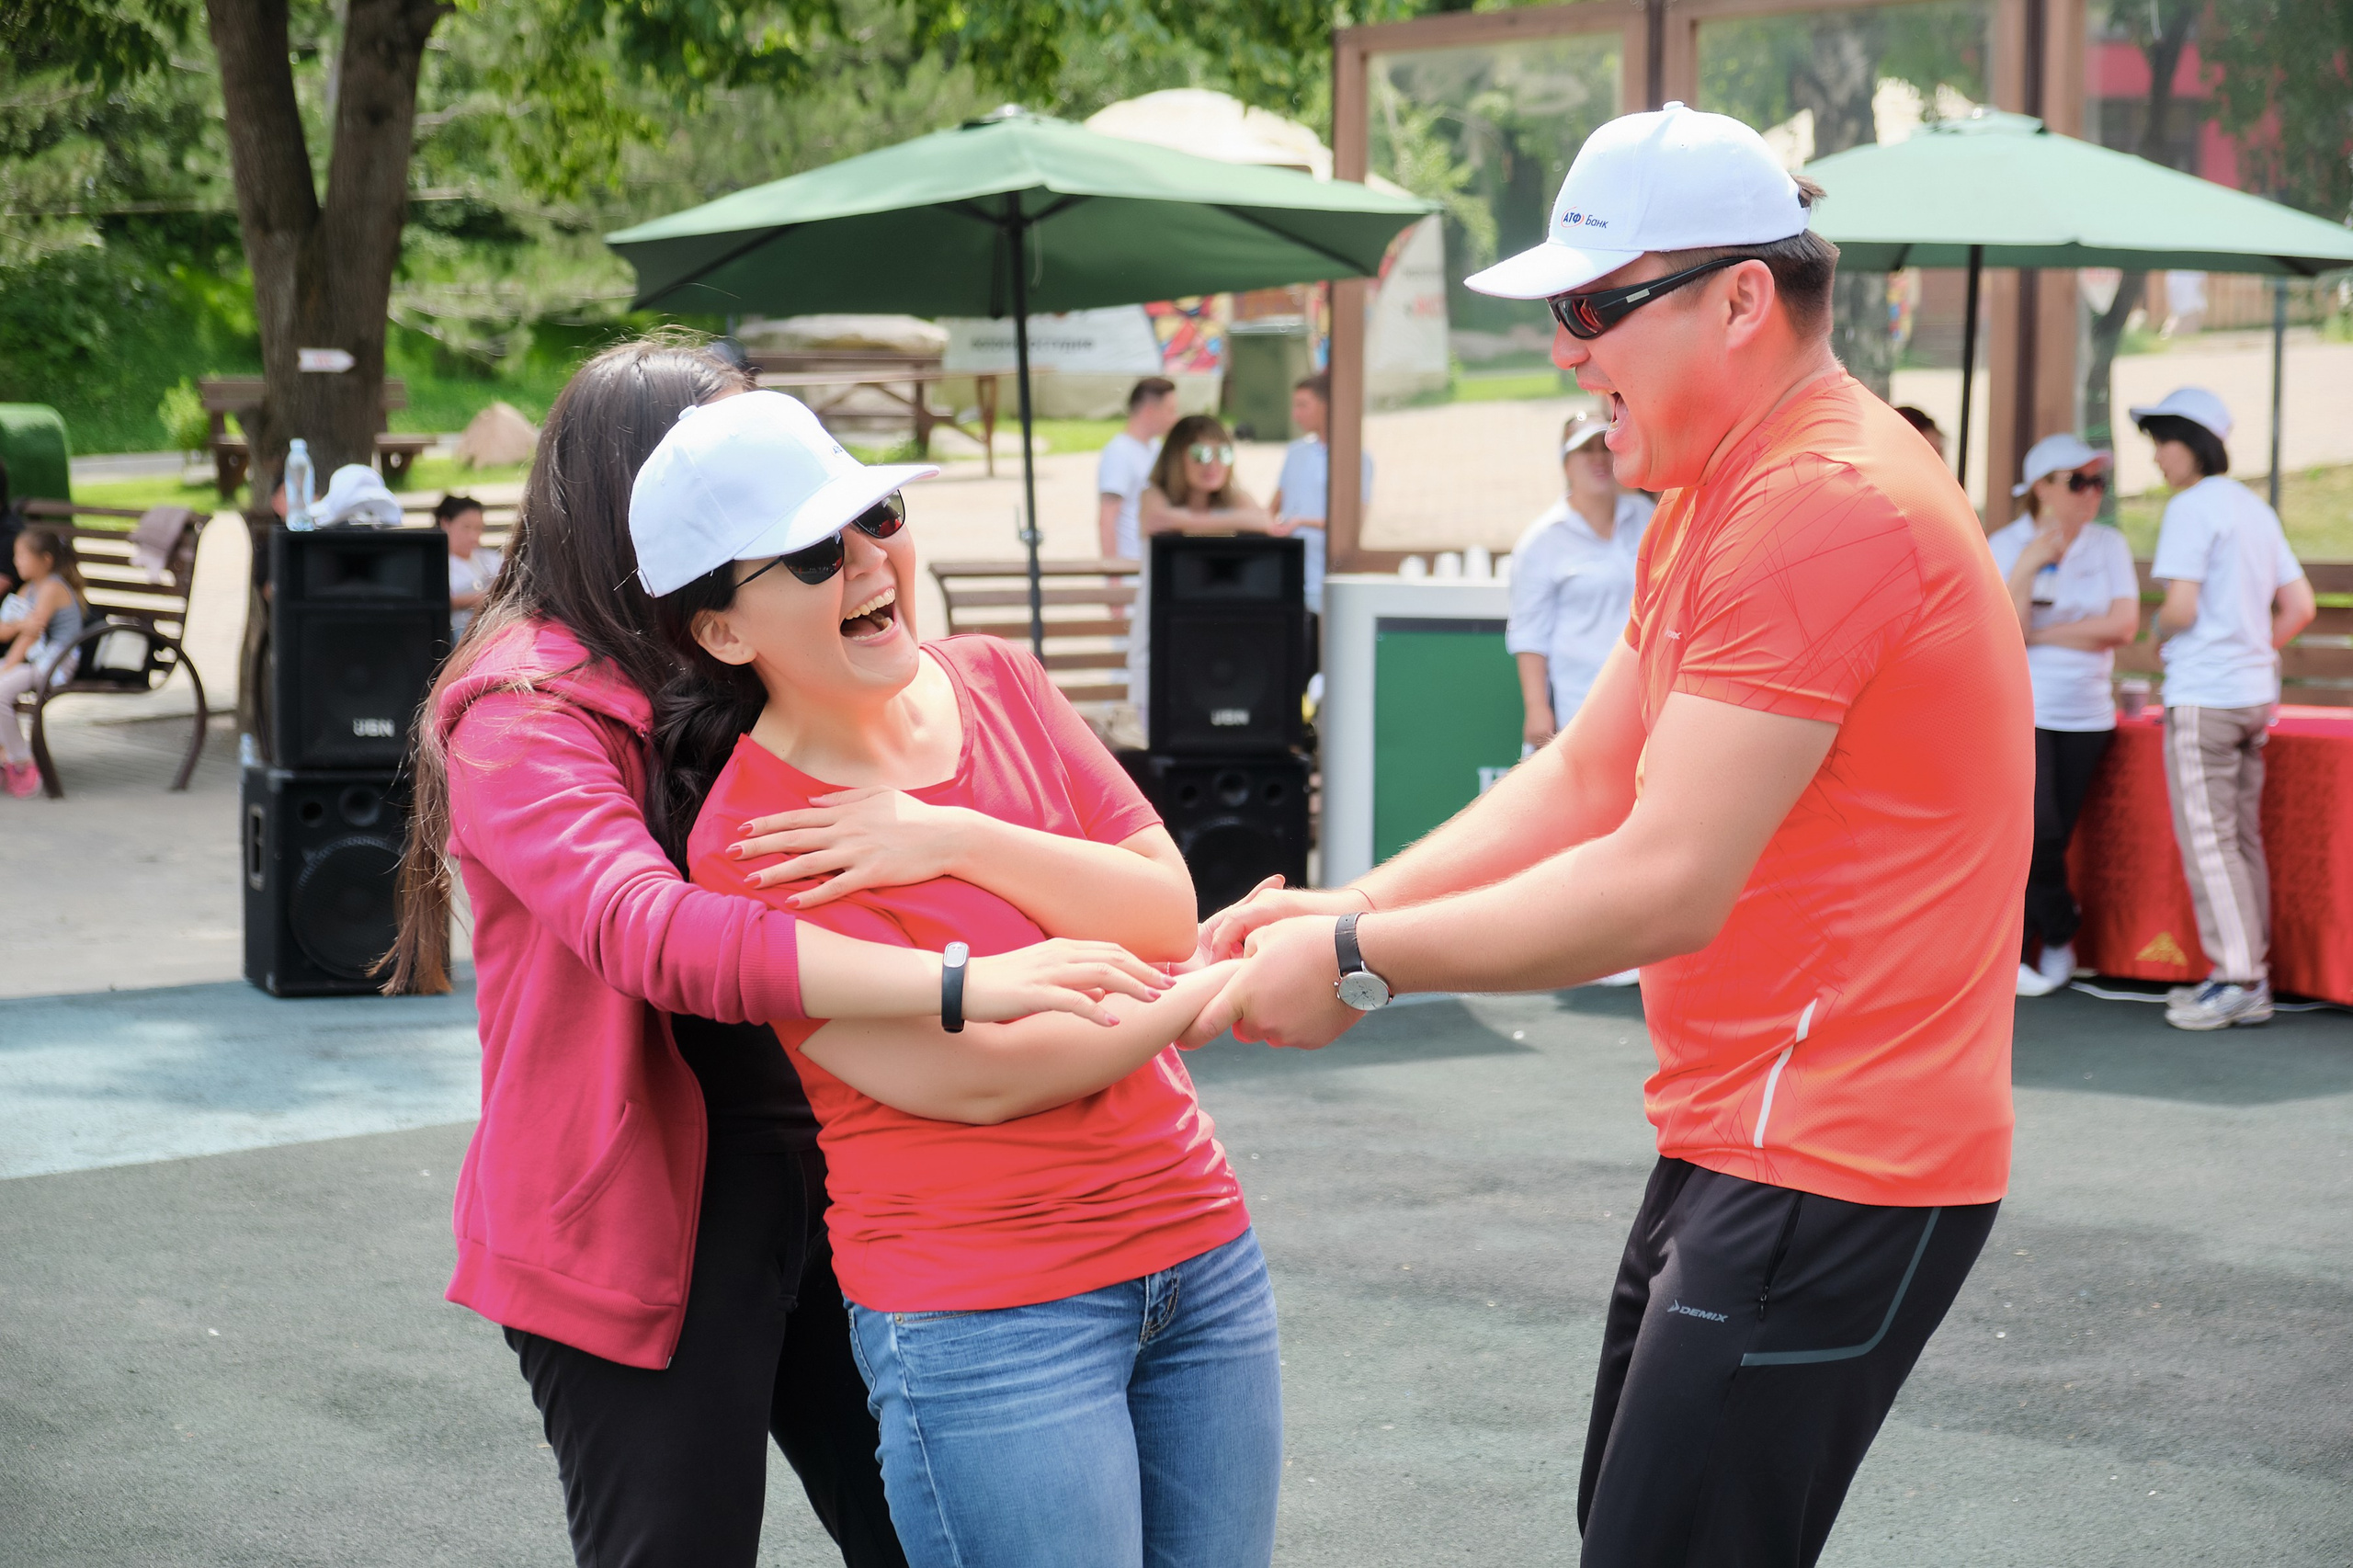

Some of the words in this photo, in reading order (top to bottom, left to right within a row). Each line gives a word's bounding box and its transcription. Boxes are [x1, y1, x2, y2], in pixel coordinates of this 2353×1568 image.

[1563, 211, 1582, 223] АТФ
[1586, 214, 1609, 229] Банк
[1679, 1305, 1729, 1324] DEMIX
